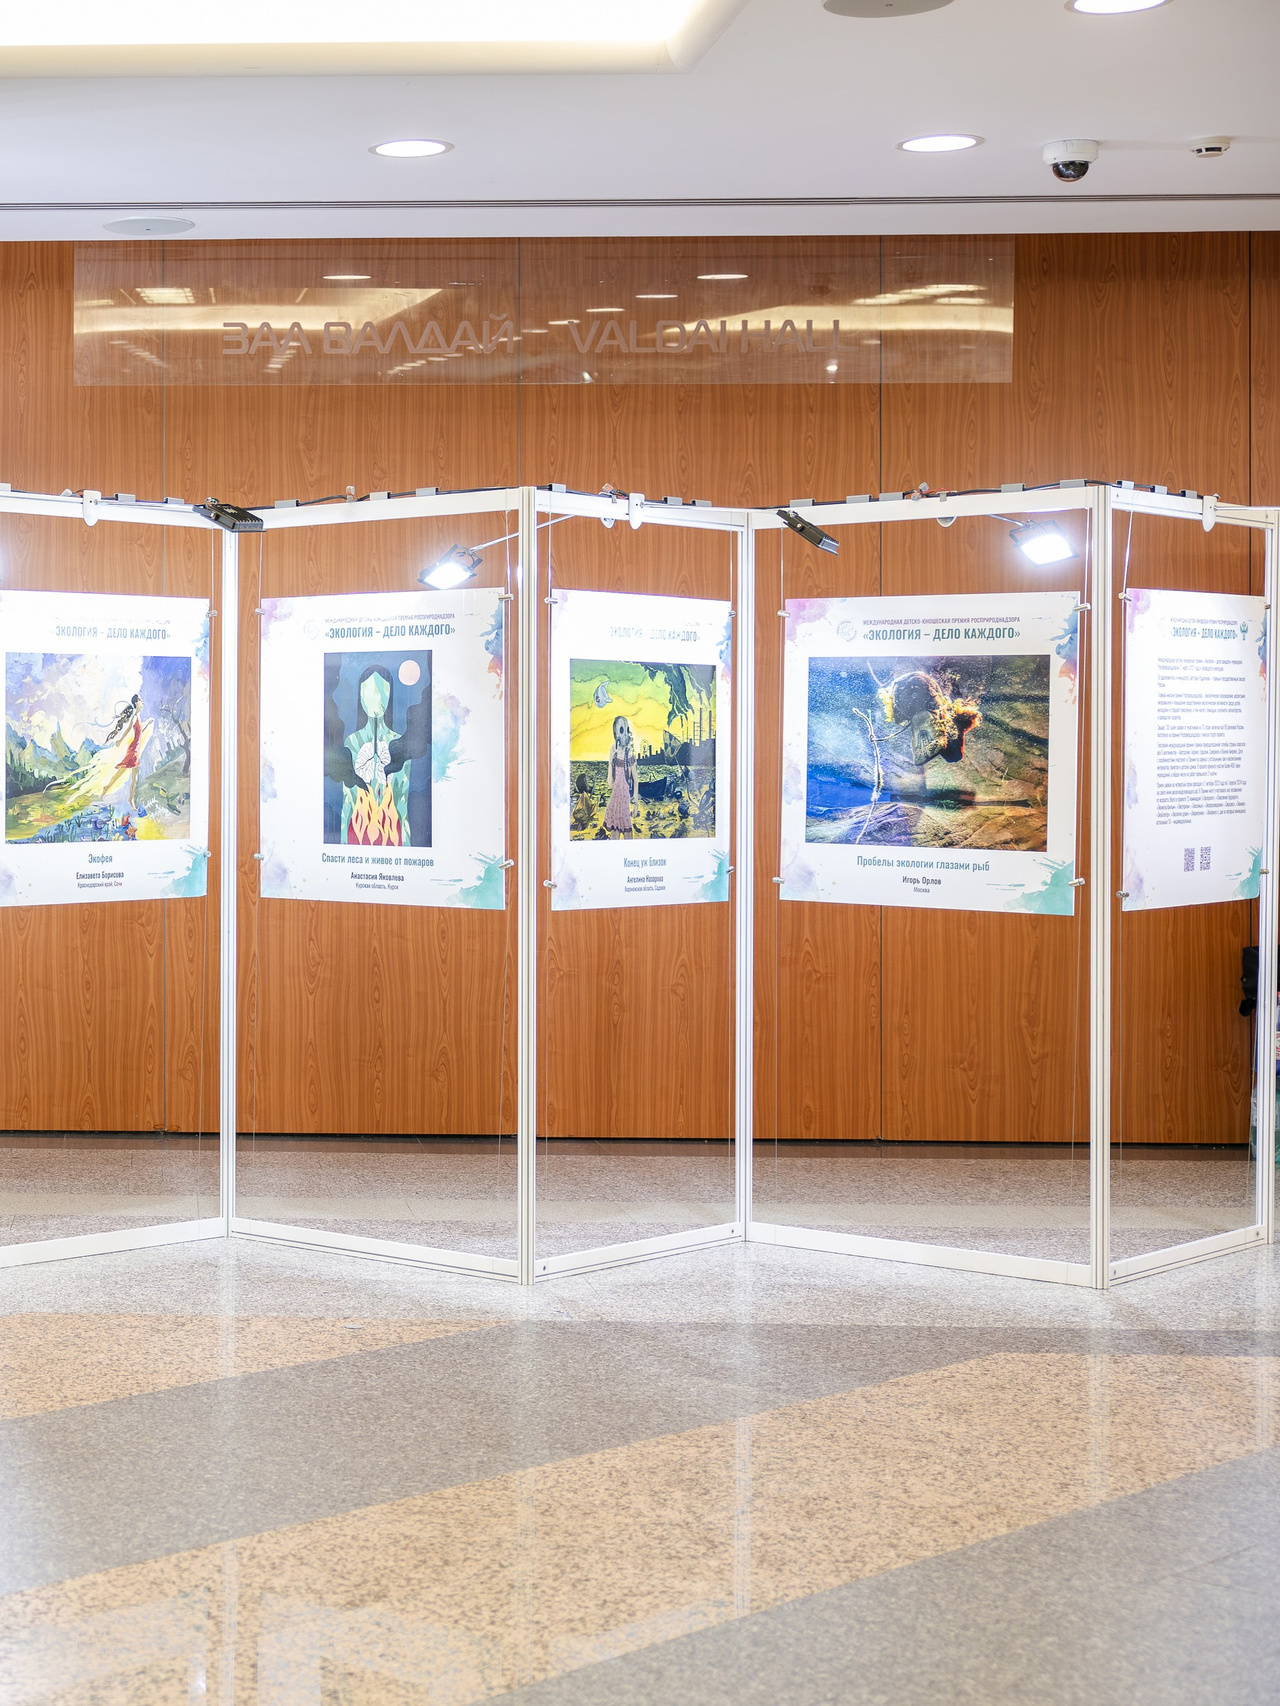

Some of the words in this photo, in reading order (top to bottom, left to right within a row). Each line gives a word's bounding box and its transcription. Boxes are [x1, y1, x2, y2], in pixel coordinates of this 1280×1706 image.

[222, 320, 313, 354] ЗАЛ
[323, 312, 514, 354] ВАЛДАЙ
[567, 319, 727, 353] VALDAI
[741, 319, 858, 353] HALL
[414, 613, 456, 621] РОСПРИРОДНАДЗОРА
[863, 618, 903, 626] МЕЖДУНАРОДНАЯ
[903, 617, 951, 625] ДЕТСКО-ЮНОШЕСКАЯ
[971, 616, 1021, 624] РОСПРИРОДНАДЗОРА
[51, 626, 98, 638] ЭКОЛОГИЯ
[107, 627, 127, 639] ДЕЛО
[325, 626, 373, 639] «ЭКОЛОГИЯ
[383, 625, 406, 638] ДЕЛО
[409, 623, 456, 637] КАЖДОГО»
[863, 628, 921, 641] «ЭКОЛОГИЯ
[933, 628, 961, 641] ДЕЛО
[964, 627, 1021, 640] КАЖДОГО»
[88, 853, 113, 865] Экофея
[322, 852, 345, 863] Спасти
[347, 856, 363, 864] леса
[365, 856, 370, 864] и
[371, 857, 393, 865] живое
[394, 857, 402, 866] от
[404, 858, 434, 868] пожаров
[623, 857, 640, 868] Конец
[649, 856, 667, 866] близок
[857, 856, 894, 867] Пробелы
[896, 859, 934, 869] экологии
[936, 861, 970, 870] глазами
[972, 861, 990, 872] рыб
[76, 872, 101, 881] Елизавета
[101, 871, 124, 880] Борисова
[351, 871, 377, 880] Анастасия
[379, 873, 404, 882] Яковлева
[902, 876, 920, 885] Игорь
[922, 877, 942, 886] Орлов
